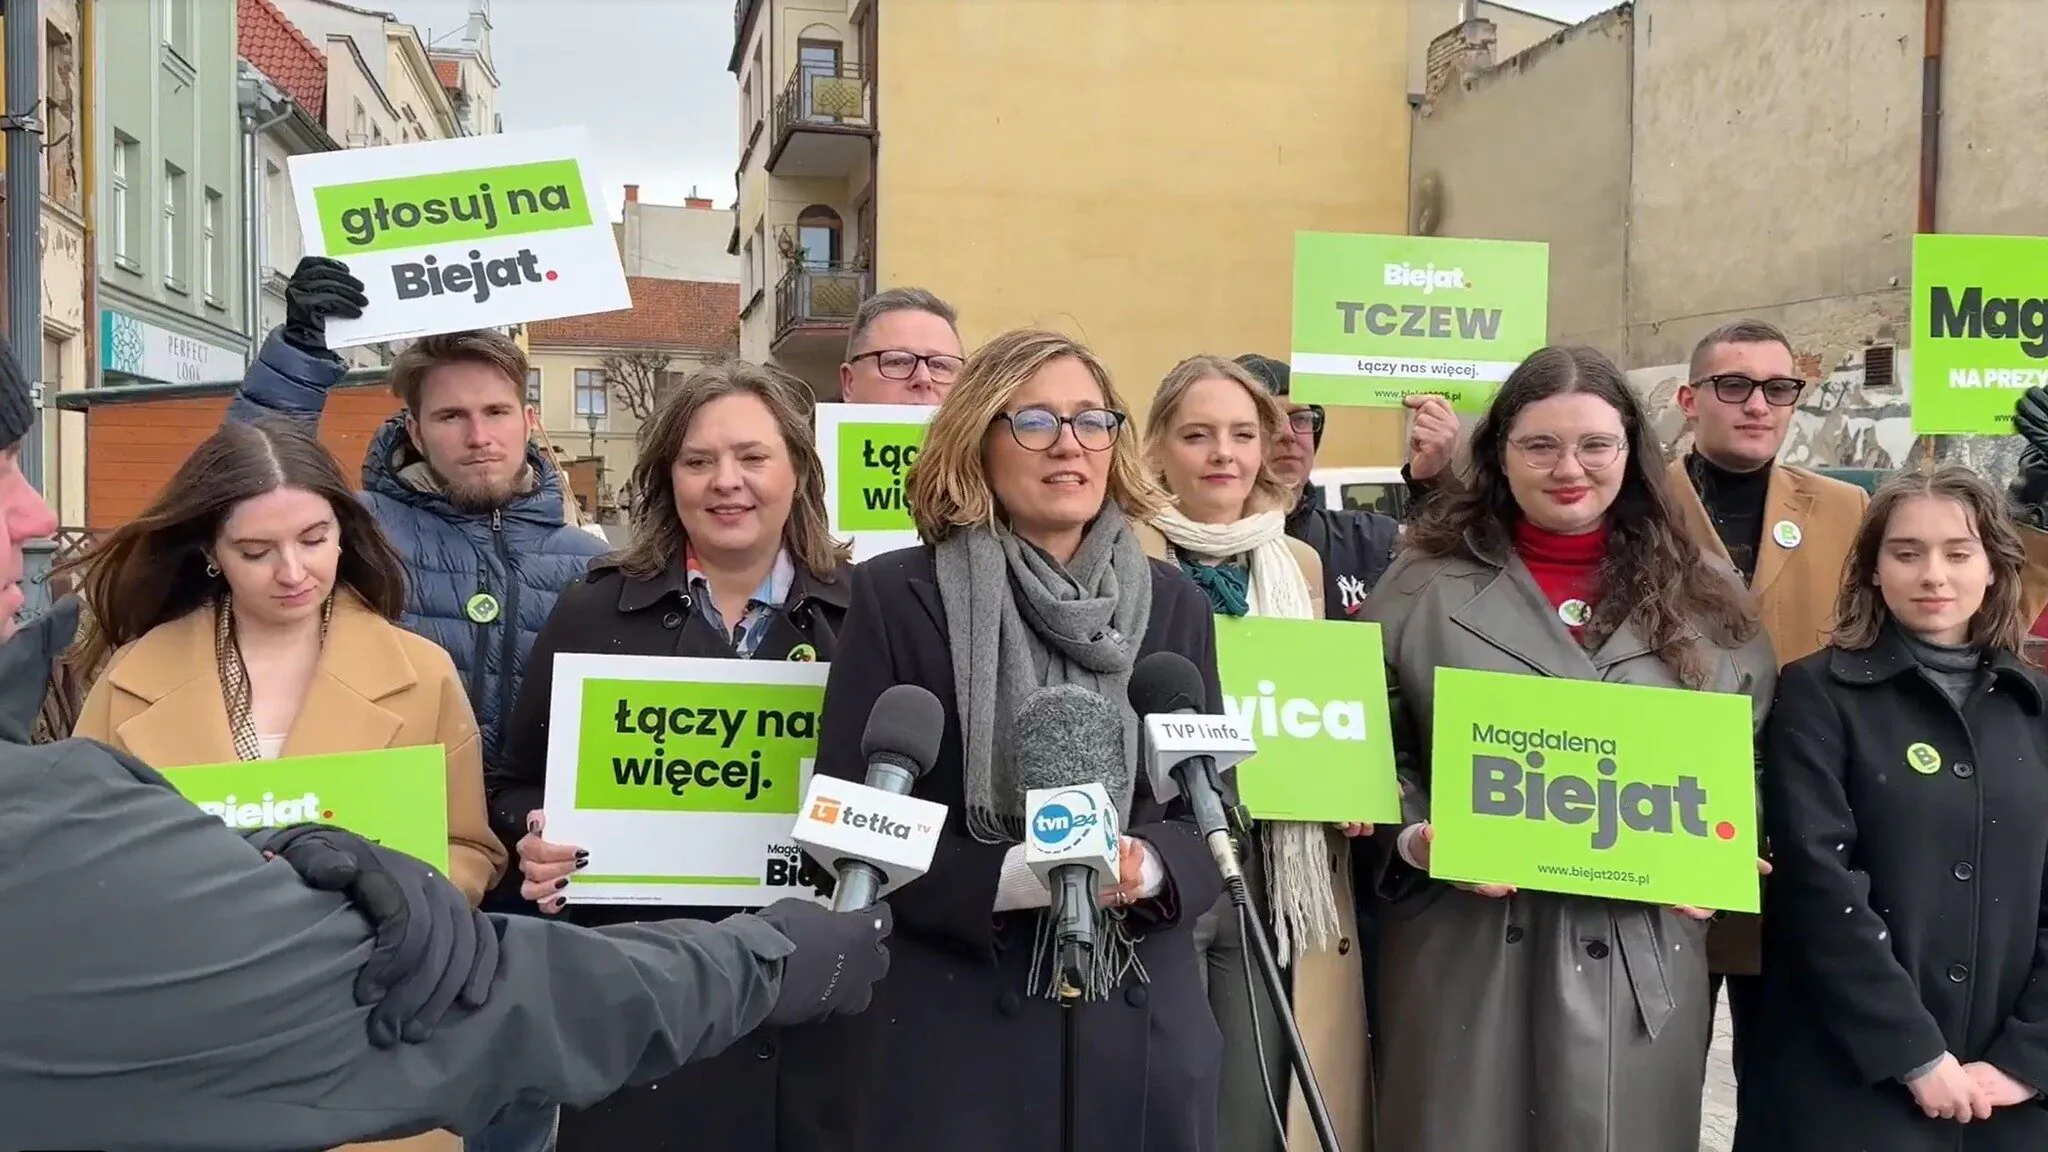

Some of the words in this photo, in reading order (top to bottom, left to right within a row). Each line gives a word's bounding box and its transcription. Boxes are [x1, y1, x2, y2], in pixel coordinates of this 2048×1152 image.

[341, 183, 498, 246] głosuj
[506, 184, 570, 215] na
[391, 249, 558, 303] Biejat.
[1384, 261, 1472, 295] Biejat.
[1336, 301, 1503, 340] TCZEW
[1930, 286, 2048, 358] Mag
[167, 335, 209, 364] PERFECT
[1357, 360, 1397, 375] Łączy
[1401, 363, 1427, 373] nas
[1431, 362, 1479, 378] więcej.
[1949, 368, 1982, 388] NA
[615, 699, 747, 748] Łączy
[1162, 723, 1195, 738] TVP
[1472, 723, 1617, 755] Magdalena
[612, 748, 772, 800] więcej.
[1472, 751, 1736, 850] Biejat.
[842, 806, 911, 840] tetka
[1537, 864, 1650, 886] www.biejat2025.pl
